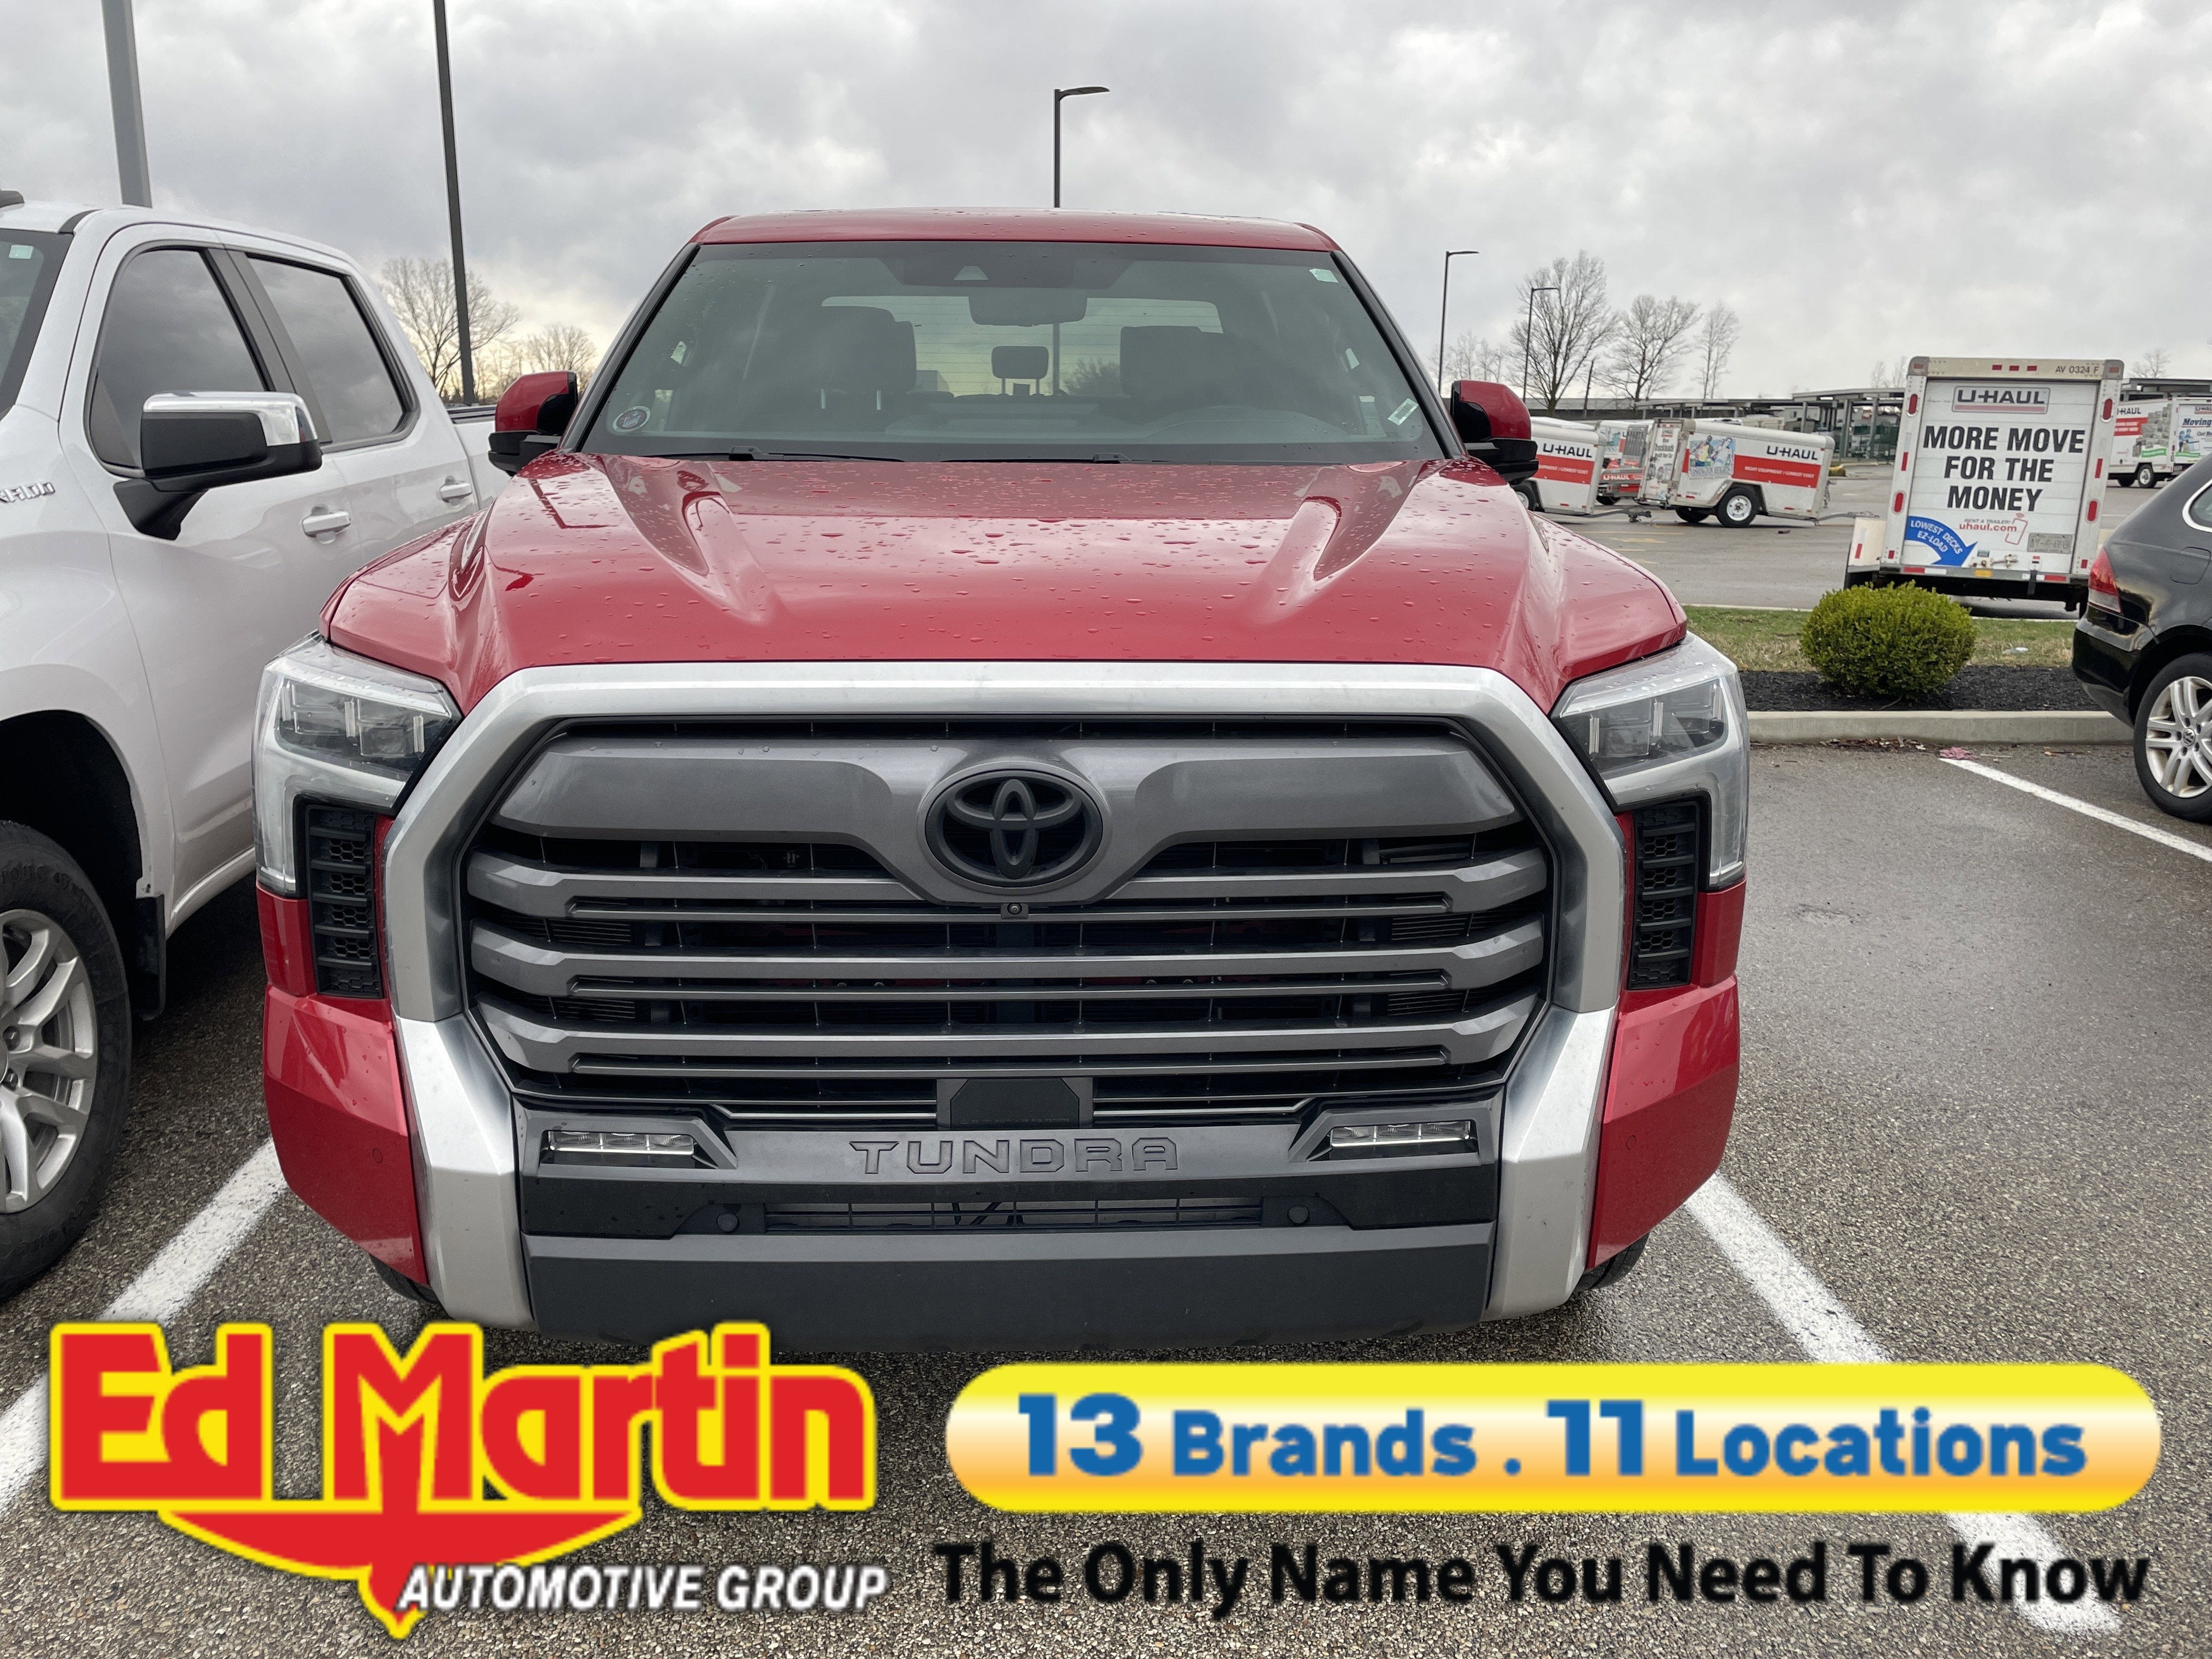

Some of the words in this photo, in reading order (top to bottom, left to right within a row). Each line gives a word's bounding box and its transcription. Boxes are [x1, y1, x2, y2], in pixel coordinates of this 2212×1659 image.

[2055, 365, 2066, 374] AV
[2069, 365, 2090, 374] 0324
[2094, 365, 2100, 374] F
[1957, 389, 2045, 405] U-HAUL
[1923, 425, 1999, 450] MORE
[2006, 427, 2086, 453] MOVE
[1543, 443, 1593, 458] U-HAUL
[1766, 445, 1818, 460] U-HAUL
[1944, 455, 1995, 481] FOR
[2005, 457, 2055, 483] THE
[1946, 485, 2043, 512] MONEY
[1910, 520, 1944, 535] LOWEST
[1959, 522, 2017, 532] uhaul.com
[1917, 530, 1948, 552] EZ-LOAD
[849, 1137, 1178, 1175] TUNDRA
